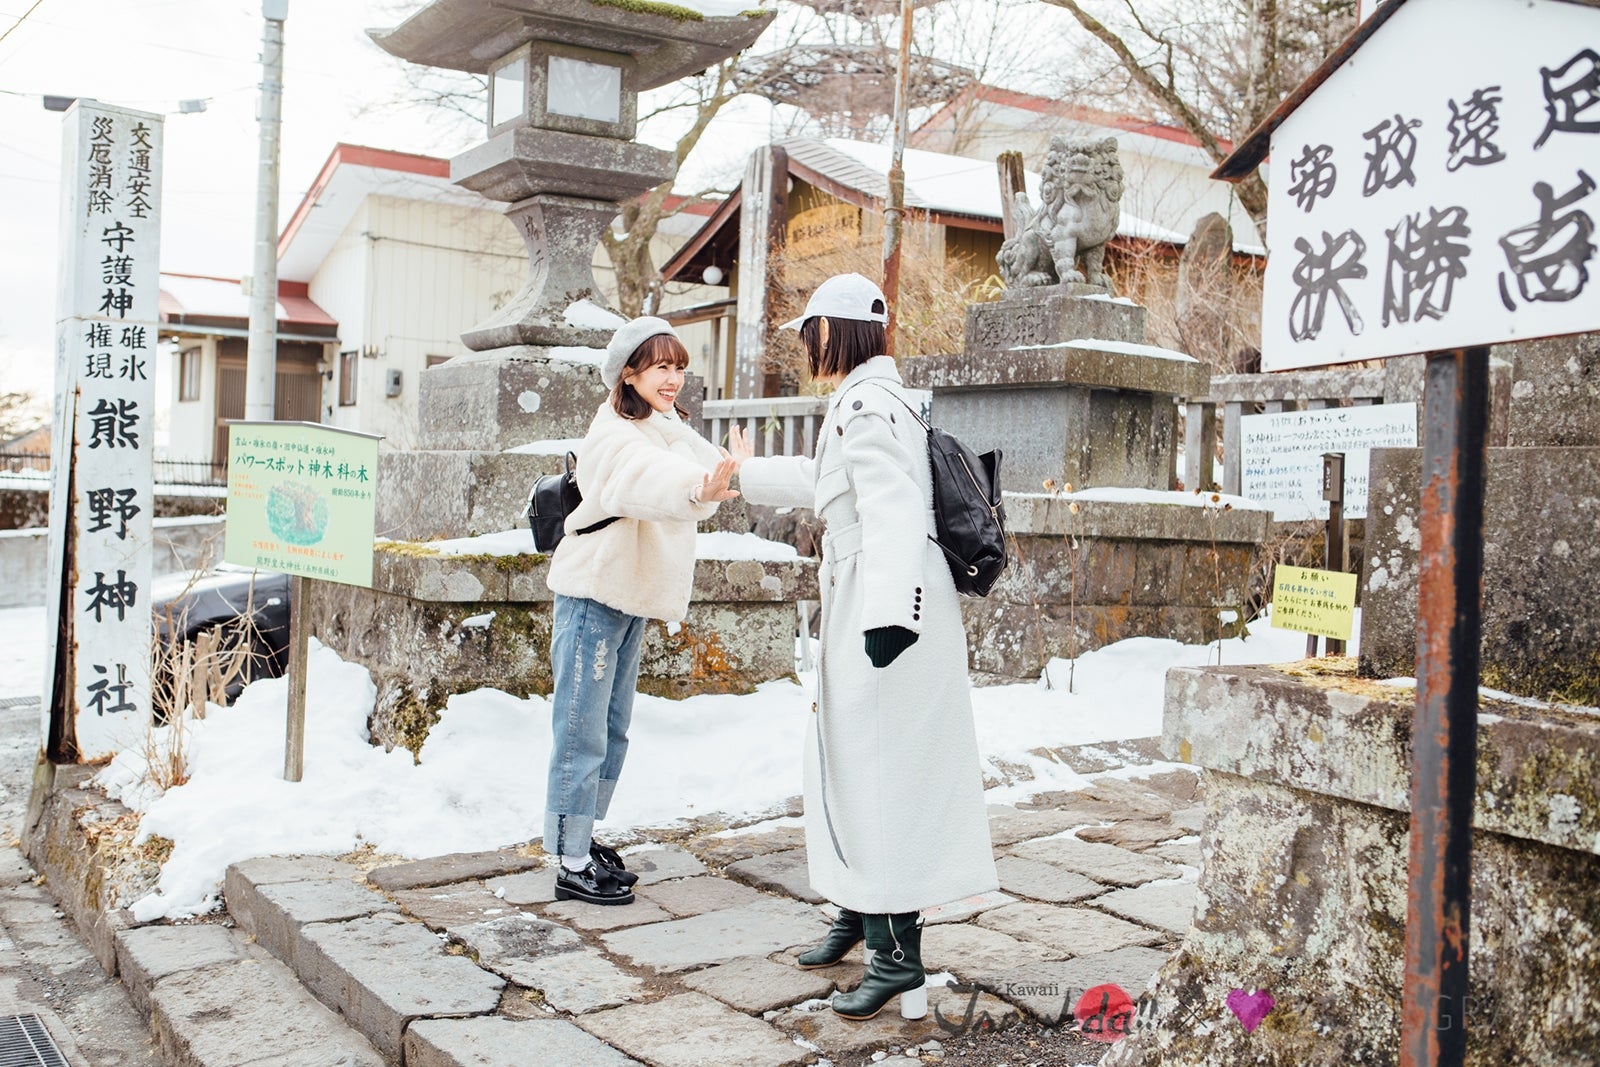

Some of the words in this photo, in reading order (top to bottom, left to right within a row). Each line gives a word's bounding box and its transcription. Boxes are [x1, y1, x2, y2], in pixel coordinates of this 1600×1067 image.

[87, 116, 115, 214] 災厄消除
[126, 121, 153, 219] 交通安全
[99, 221, 135, 319] 守護神
[85, 323, 114, 379] 権現
[119, 327, 147, 382] 碓氷
[235, 453, 305, 475] パワースポット
[309, 459, 334, 479] 神木
[85, 398, 141, 717] 熊野神社
[1301, 571, 1329, 581] お願い
